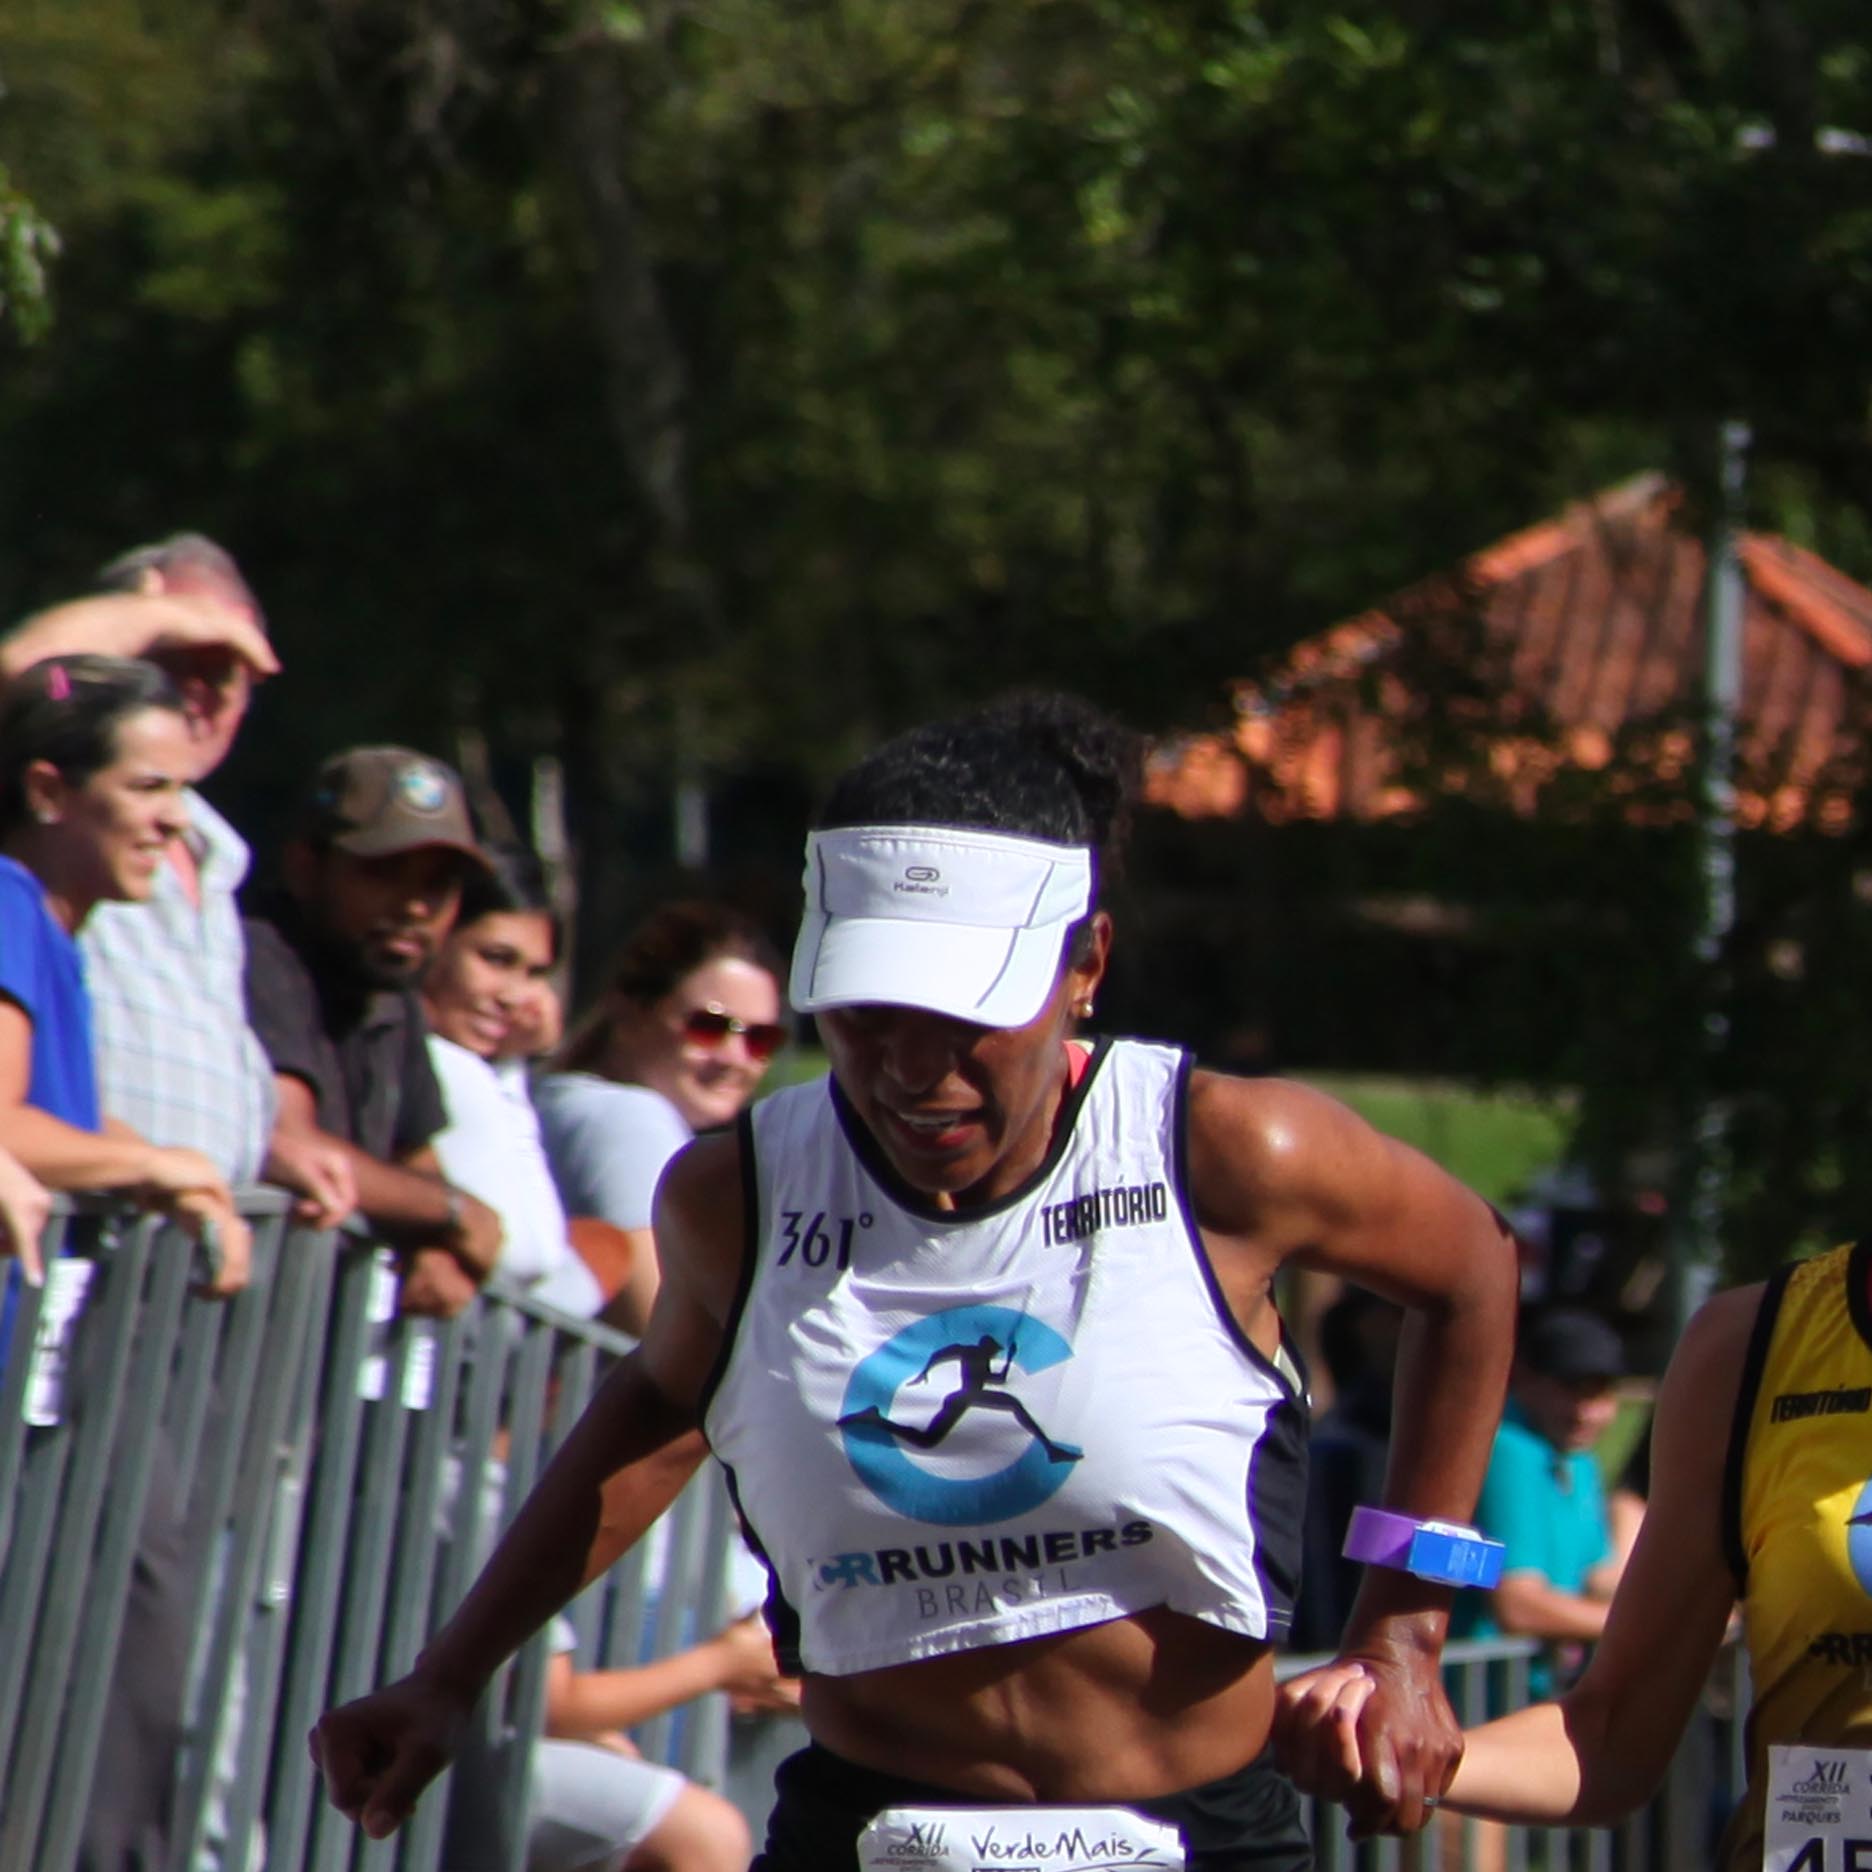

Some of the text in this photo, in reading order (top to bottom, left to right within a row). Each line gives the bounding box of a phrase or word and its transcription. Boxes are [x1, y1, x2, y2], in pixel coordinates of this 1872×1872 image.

[1041, 1174, 1167, 1248] TERRITÓRIO
[916, 1567, 1082, 1620] BRASIL
[1806, 1759, 1848, 1784] XII
[904, 1821, 947, 1847] XII
